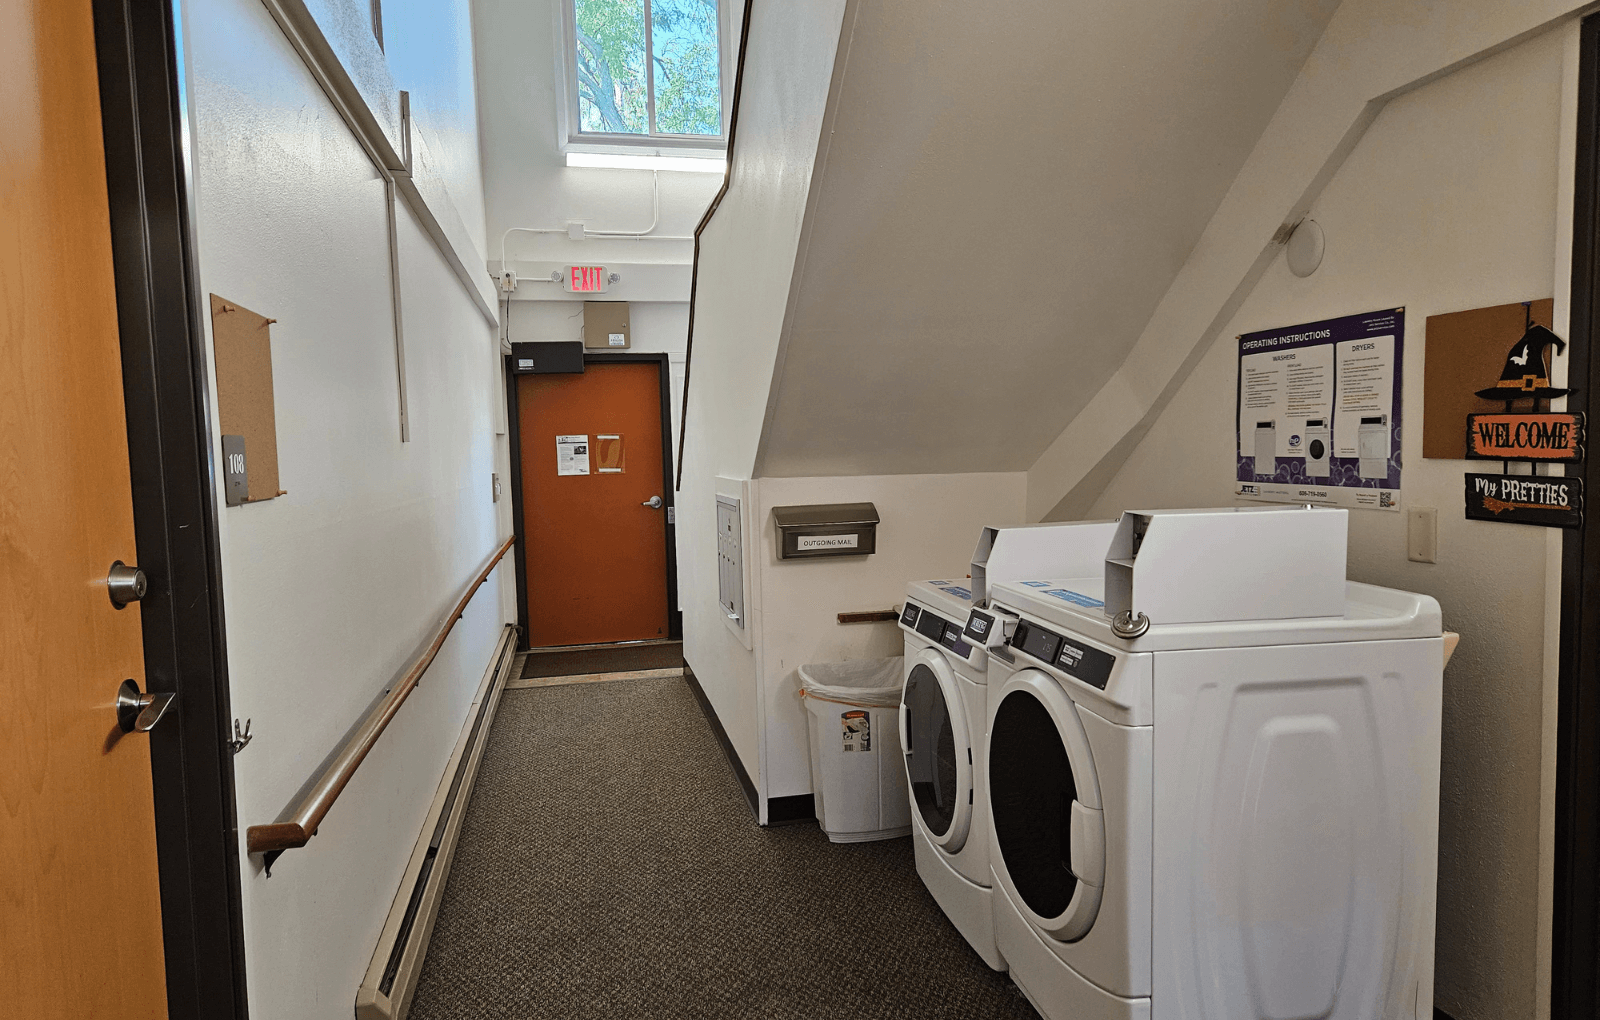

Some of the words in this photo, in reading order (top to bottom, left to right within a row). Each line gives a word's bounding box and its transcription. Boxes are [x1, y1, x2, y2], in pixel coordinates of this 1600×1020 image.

[571, 266, 603, 291] EXIT
[1242, 337, 1278, 350] OPERATING
[1279, 329, 1331, 345] INSTRUCTIONS
[1351, 343, 1375, 352] DRYERS
[1272, 353, 1296, 362] WASHERS
[1478, 421, 1570, 449] WELCOME
[228, 453, 245, 474] 108
[1501, 479, 1568, 506] PRETTIES
[803, 539, 836, 547] OUTGOING
